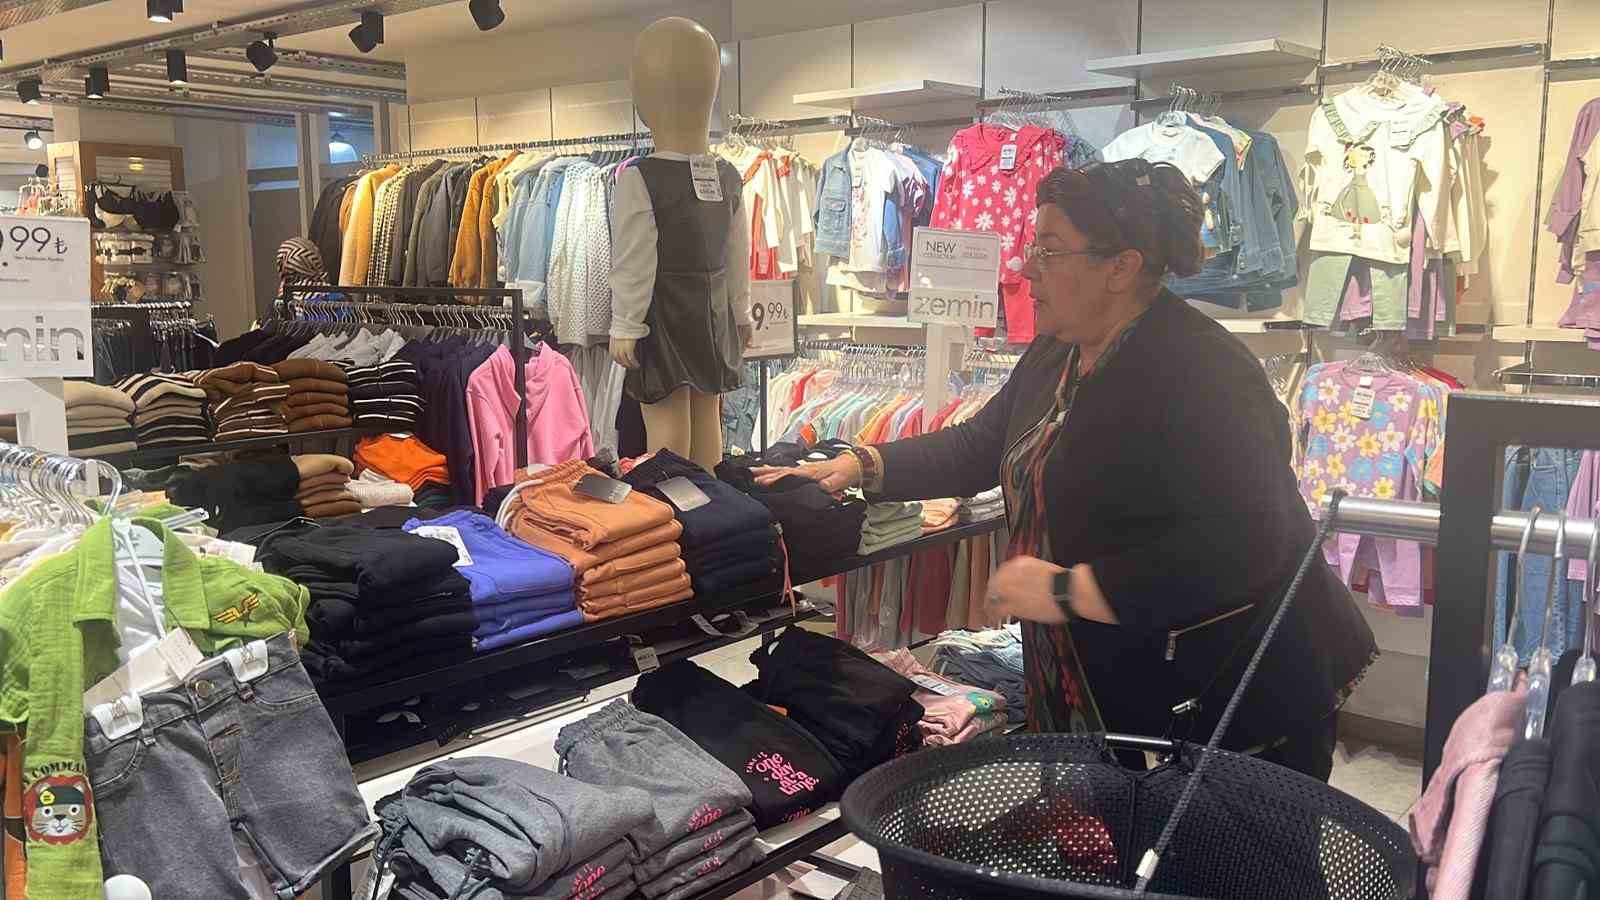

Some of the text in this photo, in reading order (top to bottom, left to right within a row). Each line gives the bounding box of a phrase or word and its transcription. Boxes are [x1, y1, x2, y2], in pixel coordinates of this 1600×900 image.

[926, 241, 957, 253] NEW
[913, 294, 995, 319] zemin
[755, 753, 783, 773] one
[771, 761, 796, 781] day
